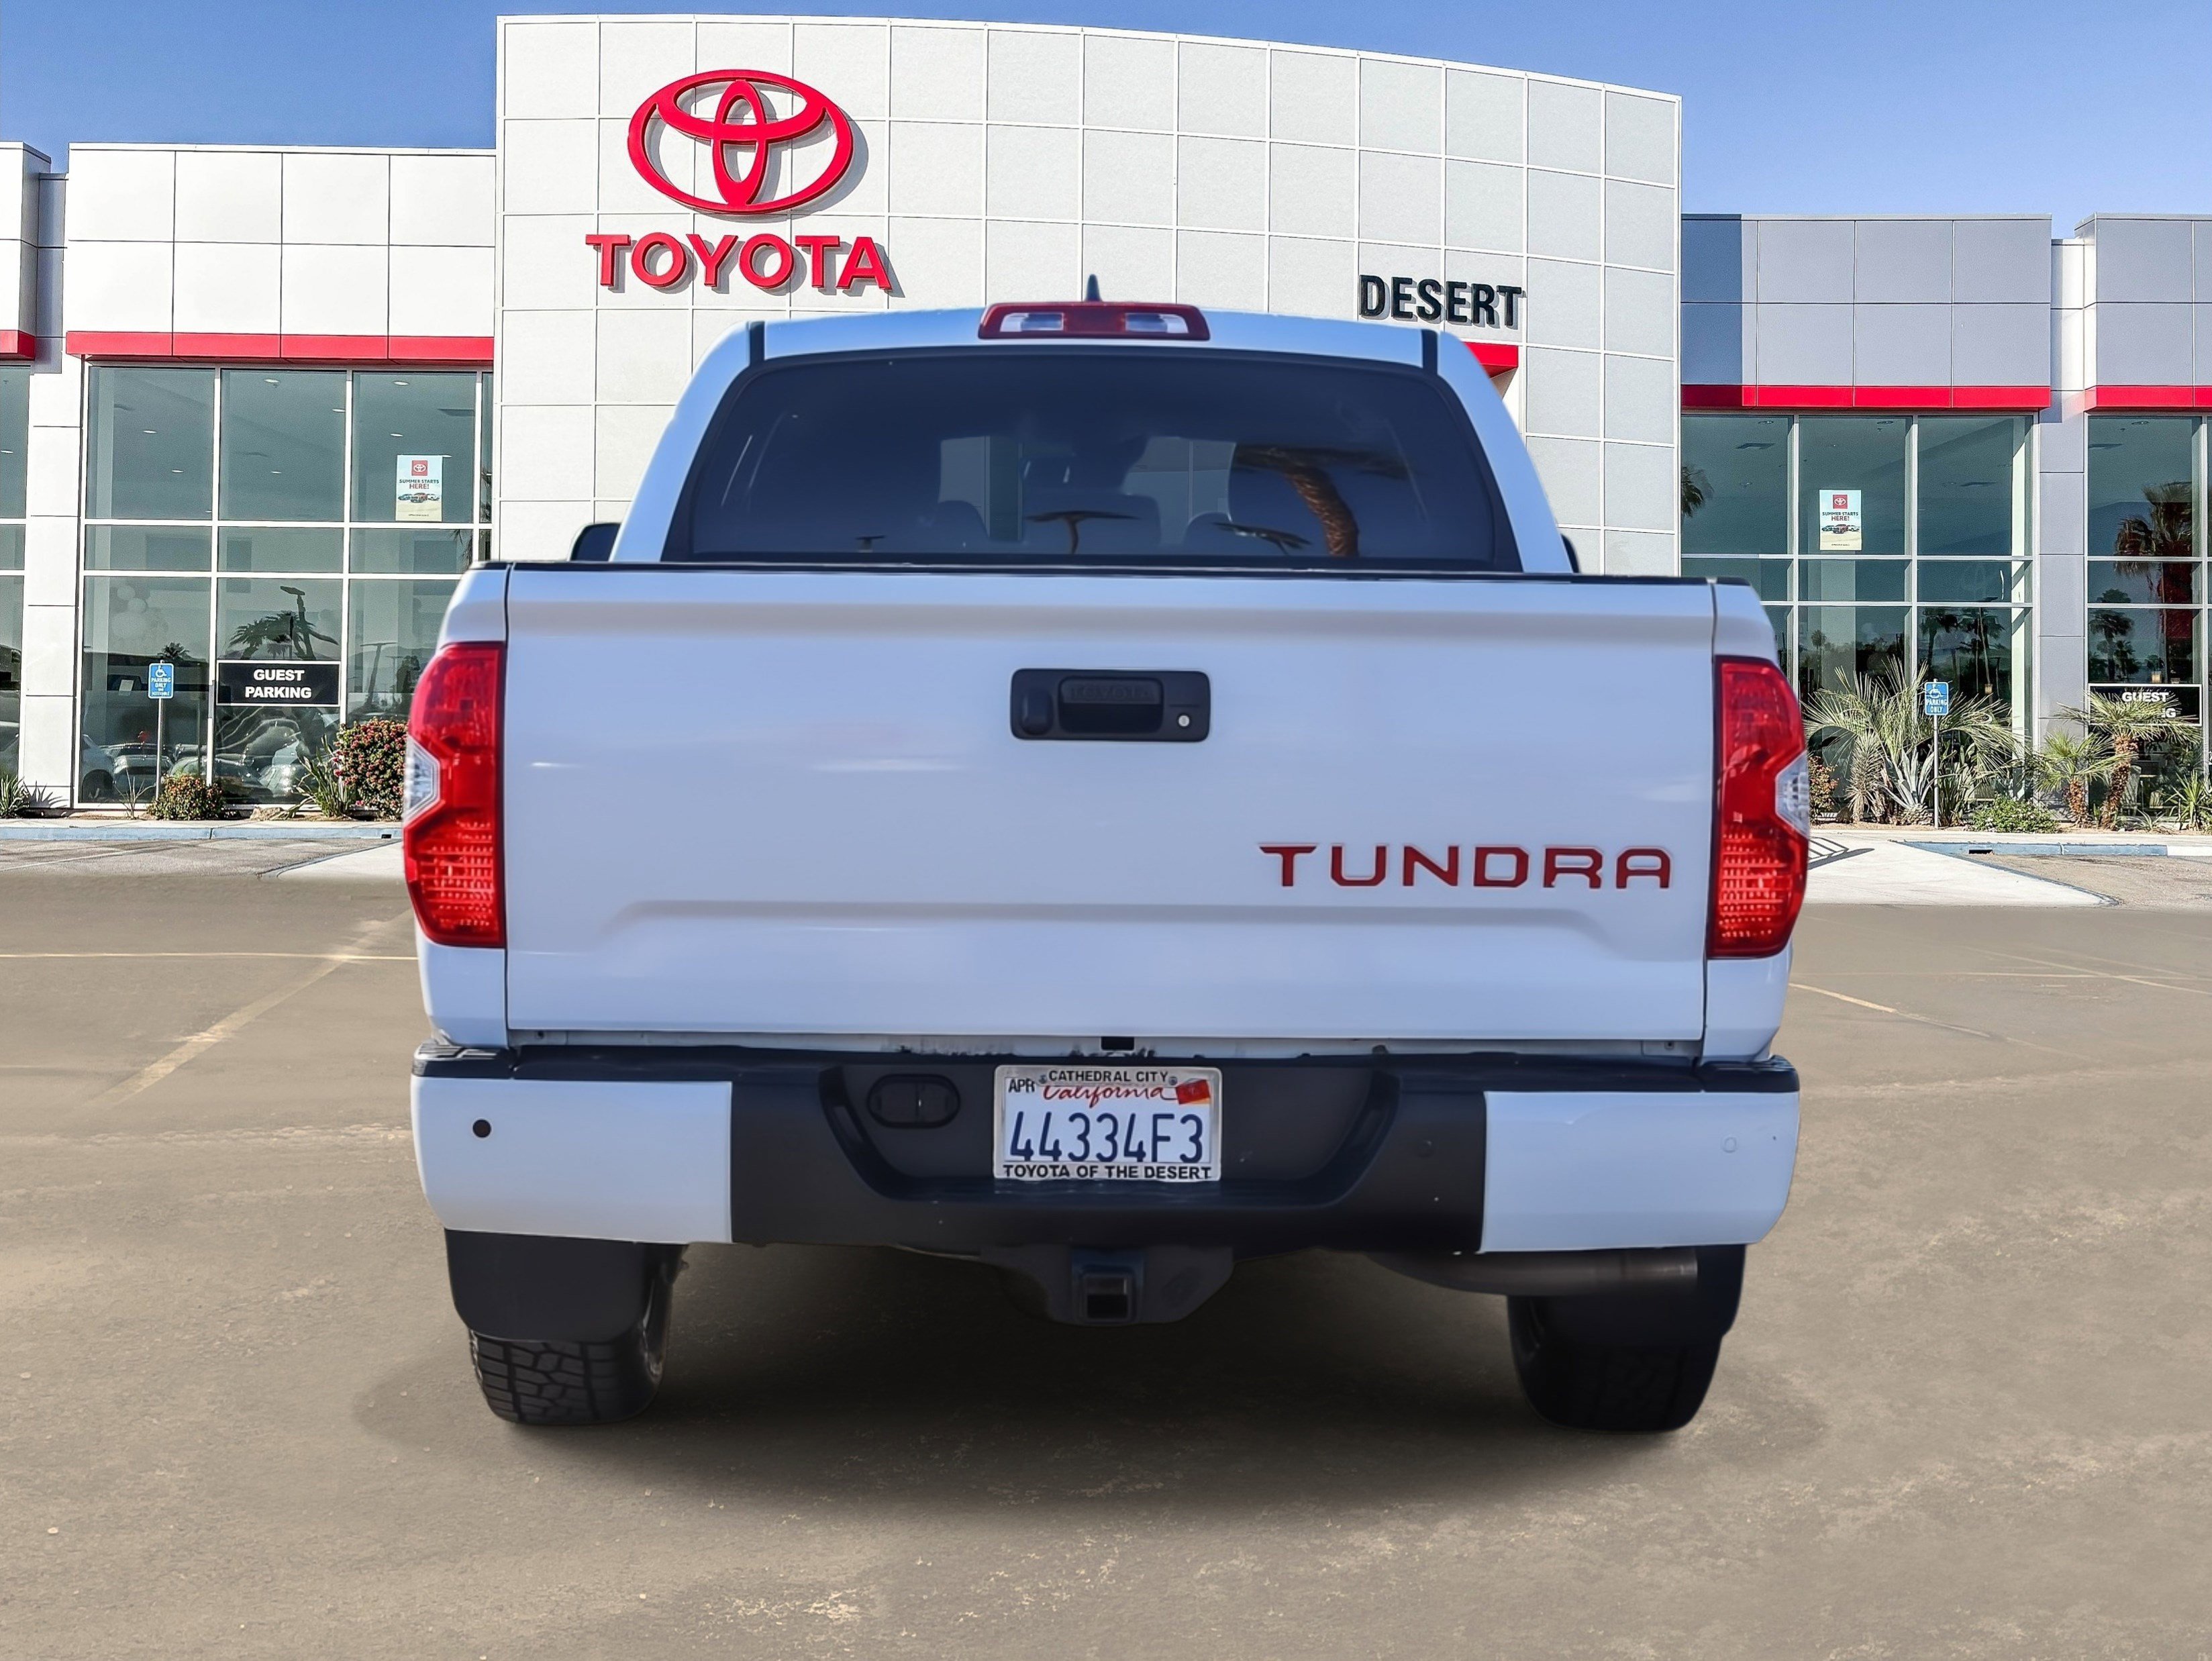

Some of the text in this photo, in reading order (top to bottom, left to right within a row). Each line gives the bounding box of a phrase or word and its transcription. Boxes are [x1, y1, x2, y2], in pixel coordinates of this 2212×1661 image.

[585, 232, 893, 291] TOYOTA
[1359, 274, 1522, 327] DESERT
[253, 668, 305, 681] GUEST
[245, 686, 312, 699] PARKING
[2121, 691, 2169, 703] GUEST
[1258, 844, 1671, 890] TUNDRA
[1048, 1070, 1169, 1083] CATHEDRAL CITY
[1008, 1078, 1036, 1093] APR
[1042, 1085, 1178, 1109] California
[1009, 1111, 1203, 1164] 44334F3
[1003, 1164, 1212, 1180] TOYOTA OF THE DESERT
